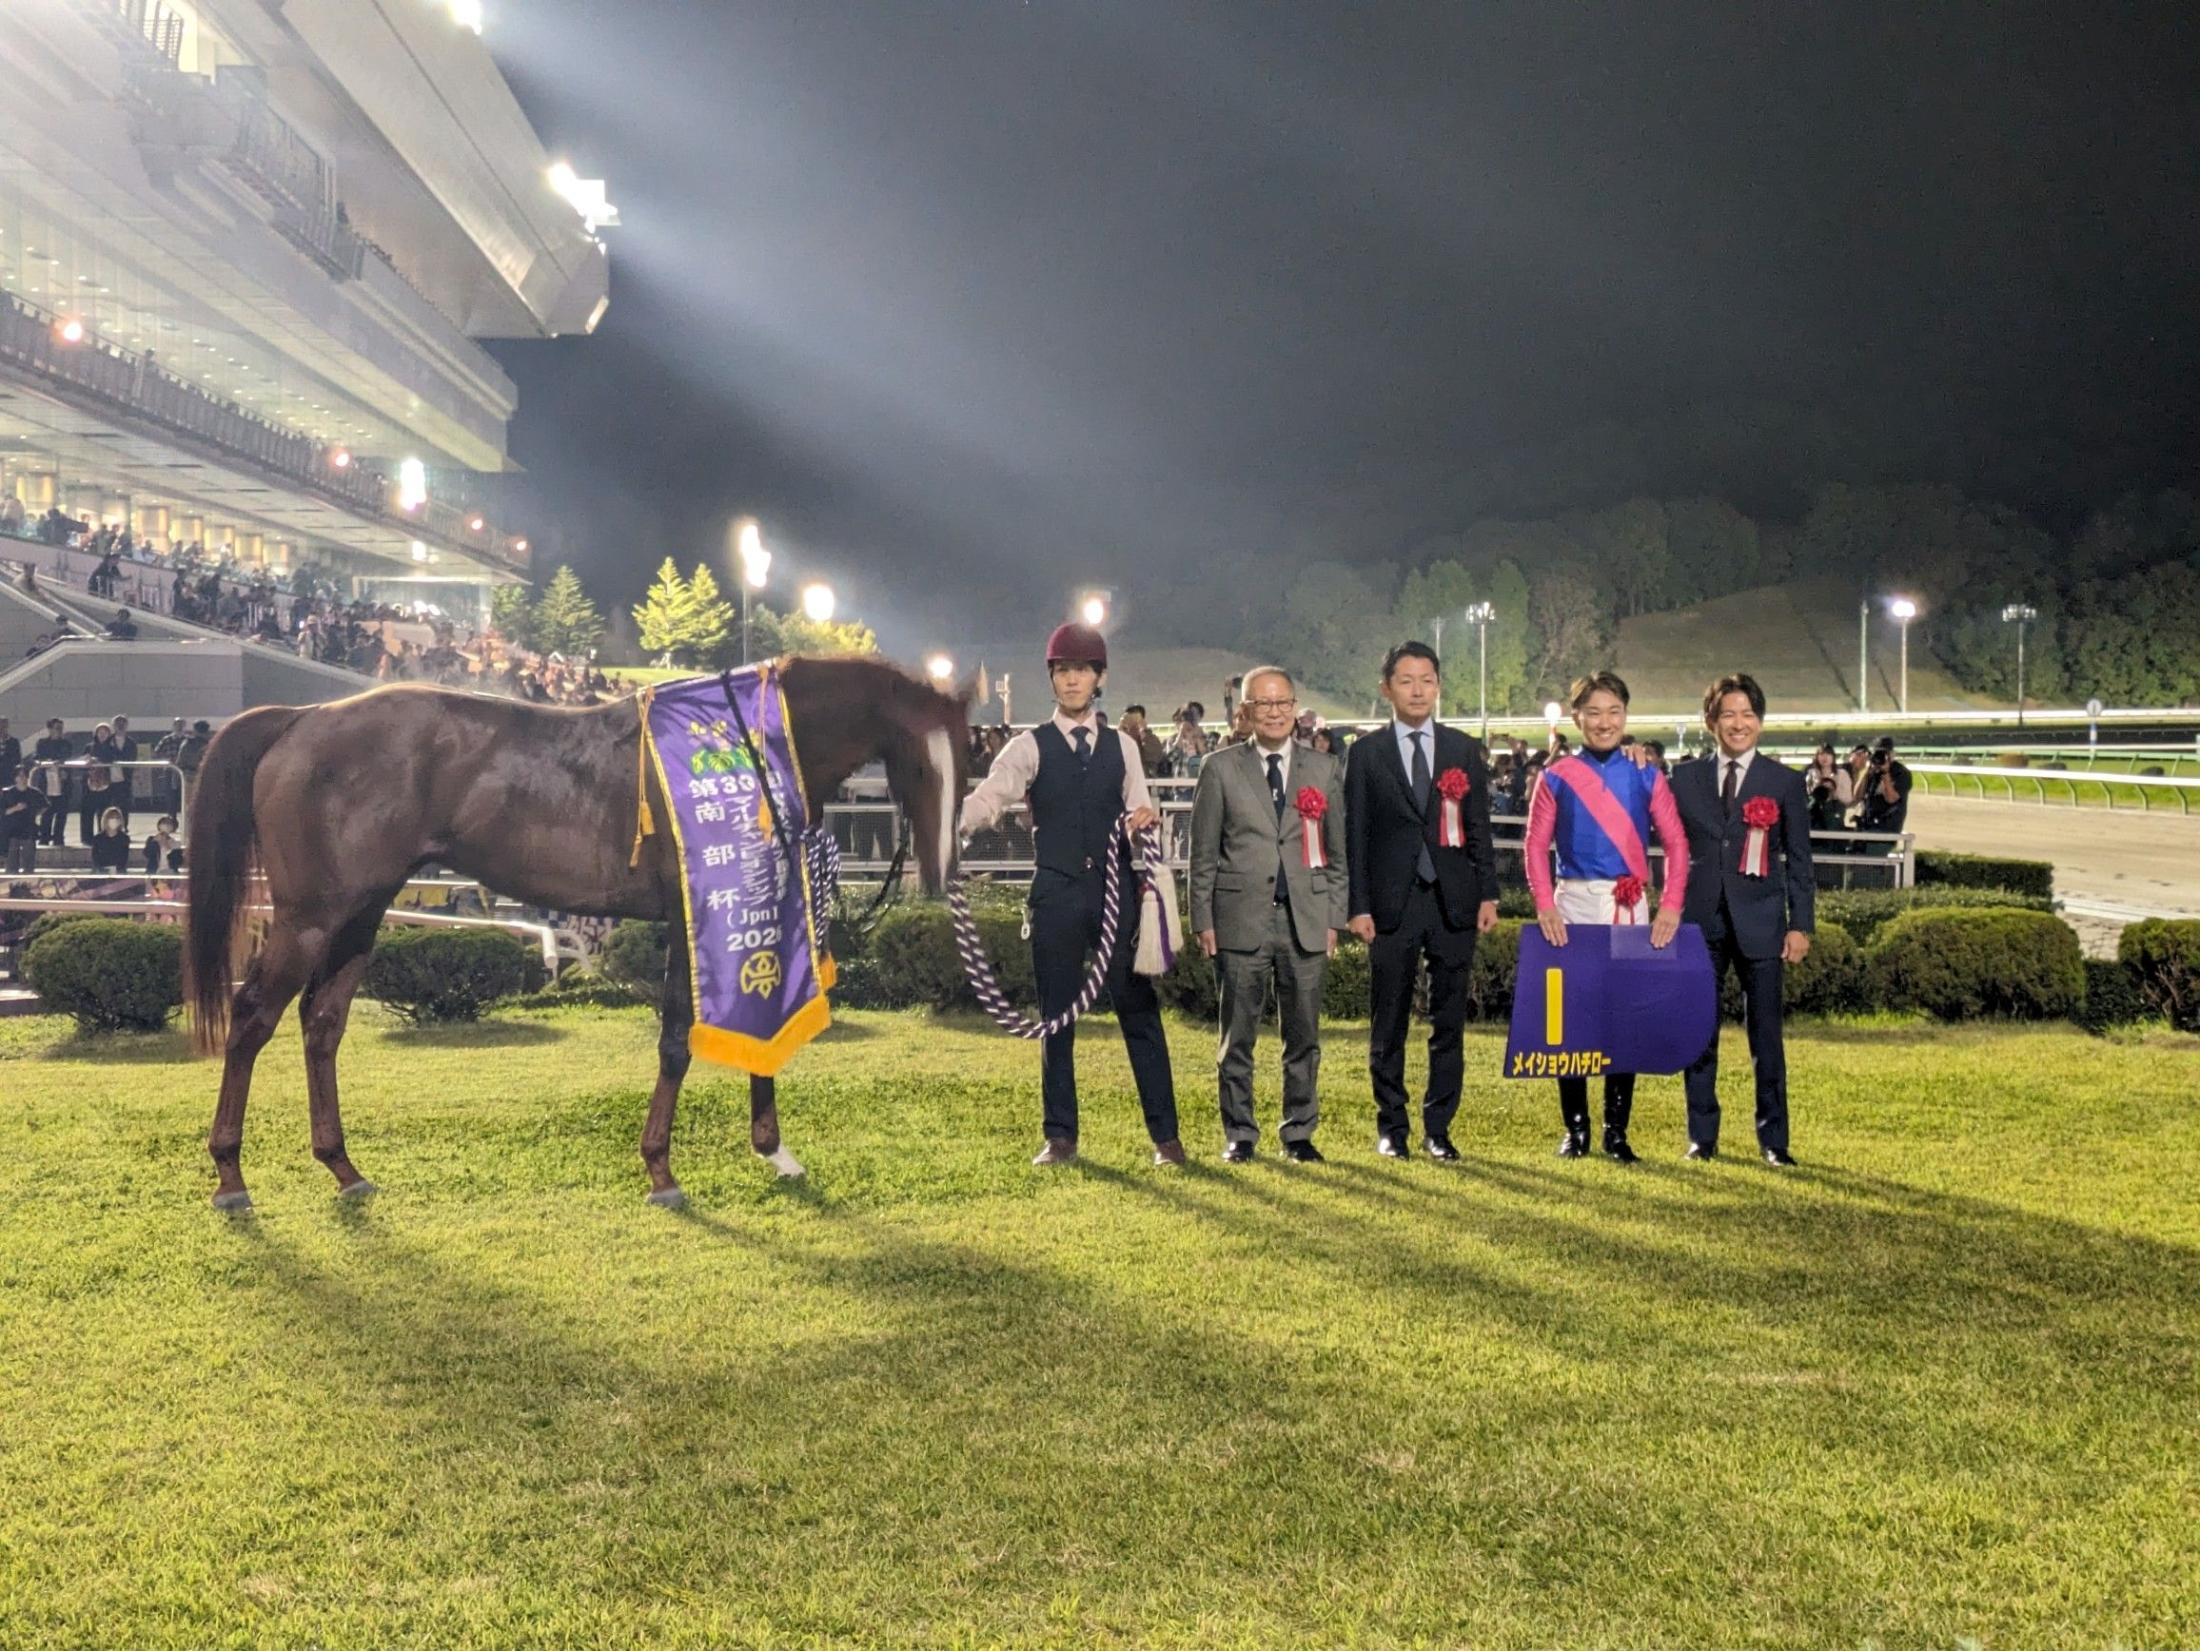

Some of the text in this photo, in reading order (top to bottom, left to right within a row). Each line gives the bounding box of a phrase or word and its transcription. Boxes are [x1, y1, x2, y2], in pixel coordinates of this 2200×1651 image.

[694, 800, 741, 911] 南部杯
[1546, 968, 1563, 1045] 1
